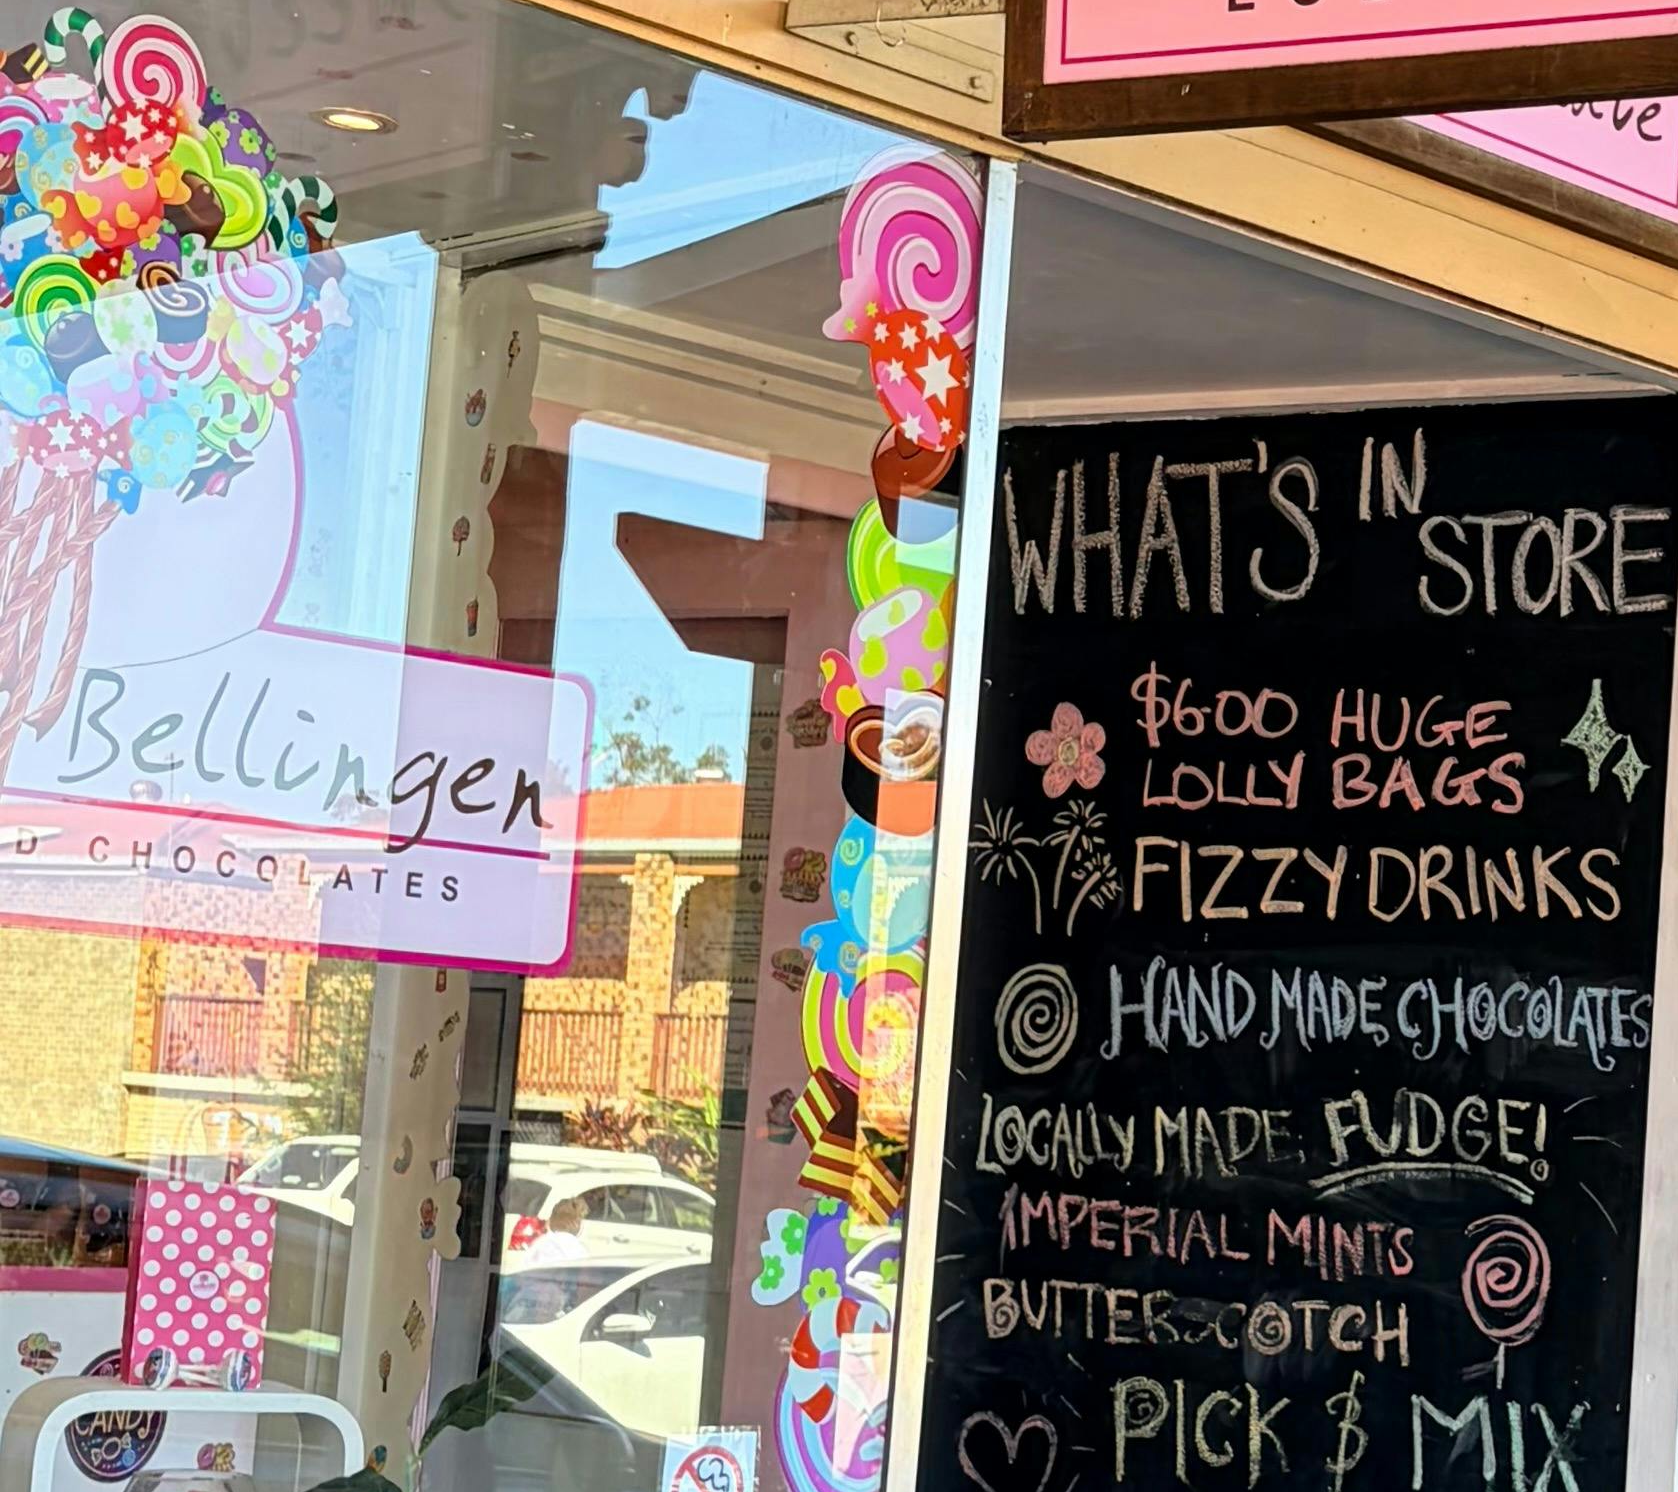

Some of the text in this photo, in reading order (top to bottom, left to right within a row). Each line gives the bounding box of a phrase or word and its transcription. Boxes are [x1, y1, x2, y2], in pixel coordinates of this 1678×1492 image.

[1003, 427, 1672, 619] WHAT'S IN STORE
[57, 669, 554, 854] Bellingen
[1331, 688, 1512, 751] HUGE
[1144, 750, 1526, 814] LOLLY BAGS
[88, 836, 459, 901] CHOCOLATES
[1133, 836, 1621, 922] FIZZY DRINKS
[1100, 955, 1653, 1071] HAND MADE CHOCOLATES
[976, 1088, 1551, 1181] LOCALLY MADE FUDGE!
[999, 1183, 1416, 1283] IMPERIAL MINTS
[1113, 1377, 1290, 1491] PICK
